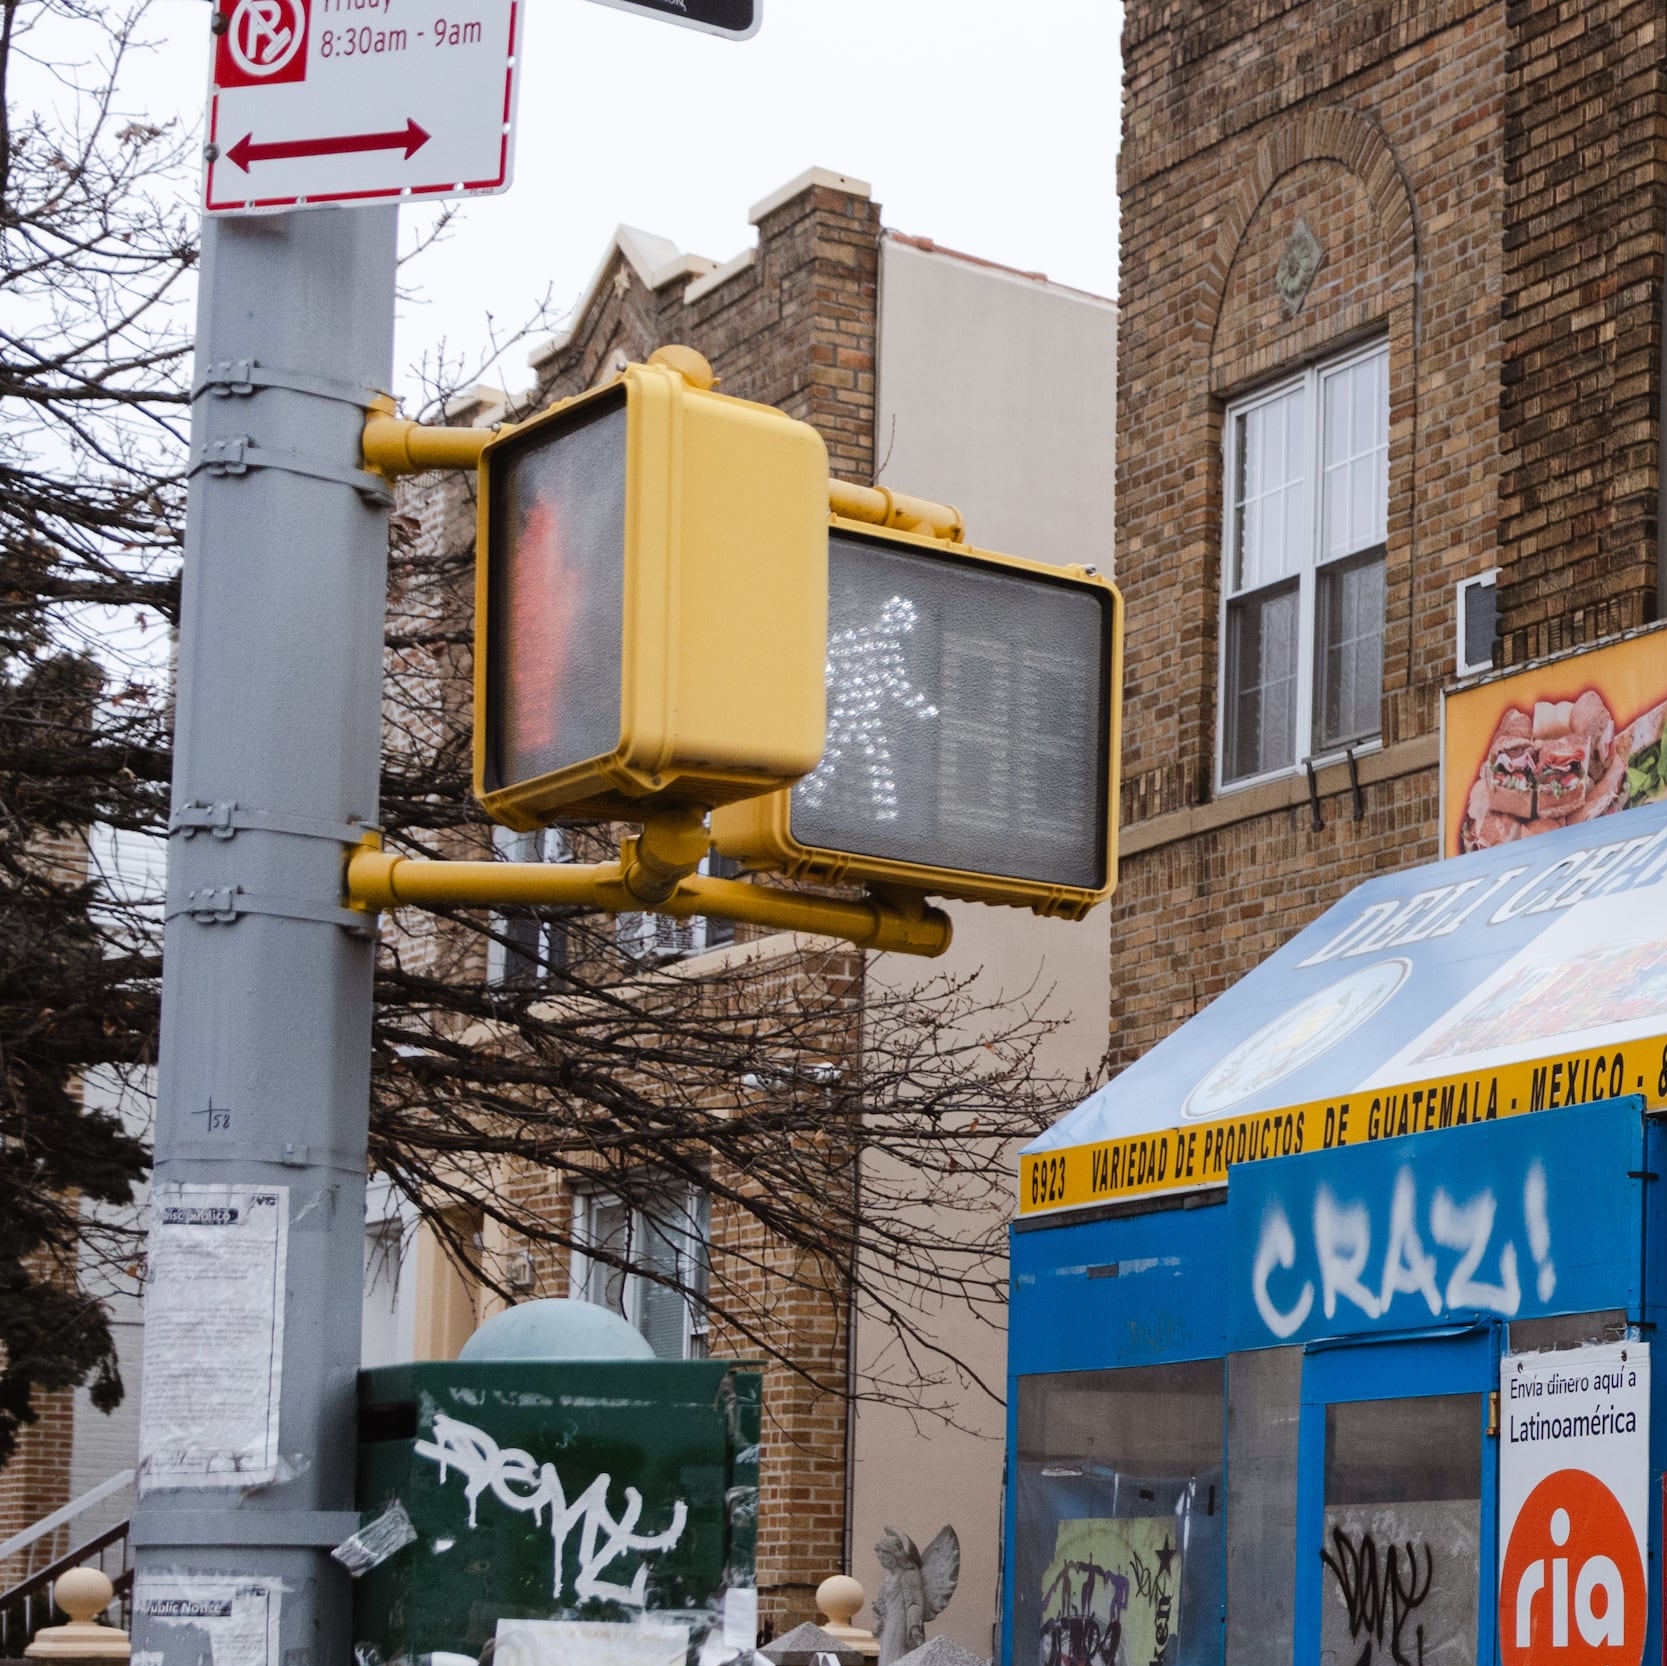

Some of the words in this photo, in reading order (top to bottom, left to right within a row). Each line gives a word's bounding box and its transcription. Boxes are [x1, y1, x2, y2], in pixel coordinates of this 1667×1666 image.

[321, 26, 407, 59] 8:30am
[434, 18, 482, 48] 9am
[1297, 876, 1484, 968] DELI
[1031, 1155, 1067, 1205] 6923
[1091, 1132, 1172, 1194] VARIEDAD
[1175, 1130, 1197, 1178] DE
[1203, 1110, 1305, 1172] PRODUCTOS
[1323, 1103, 1349, 1149] DE
[1367, 1077, 1498, 1143] GUATEMALA
[1532, 1052, 1624, 1113] MEXICO
[1510, 1371, 1543, 1400] Envía
[1547, 1373, 1589, 1394] dinero
[1594, 1370, 1626, 1395] aquí
[1628, 1374, 1636, 1389] a
[1510, 1404, 1637, 1444] Latinoamérica
[1515, 1508, 1626, 1649] ria
